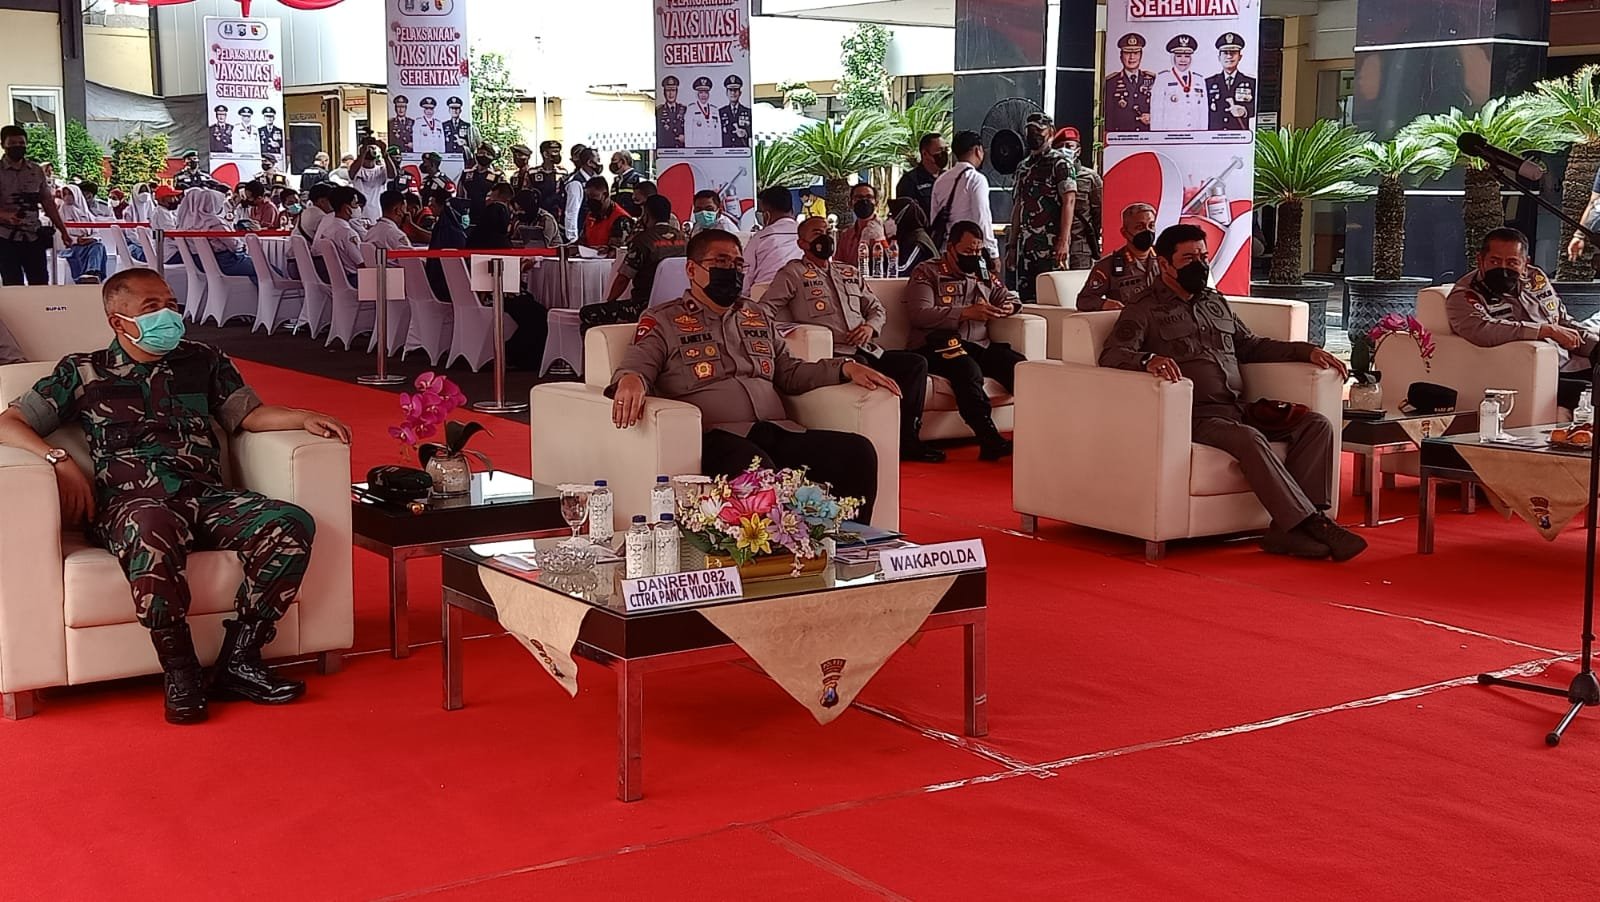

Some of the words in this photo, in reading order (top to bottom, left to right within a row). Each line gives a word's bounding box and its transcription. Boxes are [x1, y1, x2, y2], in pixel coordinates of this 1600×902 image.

[661, 9, 740, 38] VAKSINASI
[396, 27, 455, 41] PELAKSANAAN
[393, 45, 460, 65] VAKSINASI
[665, 42, 733, 64] SERENTAK
[213, 63, 274, 81] VAKSINASI
[401, 69, 459, 86] SERENTAK
[216, 83, 269, 99] SERENTAK
[743, 329, 768, 339] POLRI
[890, 548, 977, 572] WAKAPOLDA
[637, 575, 699, 593] DANREM
[702, 570, 726, 584] 082
[630, 591, 660, 608] CITRA
[660, 587, 691, 604] PANCA
[690, 584, 715, 600] YUDA
[715, 581, 737, 596] JAYA
